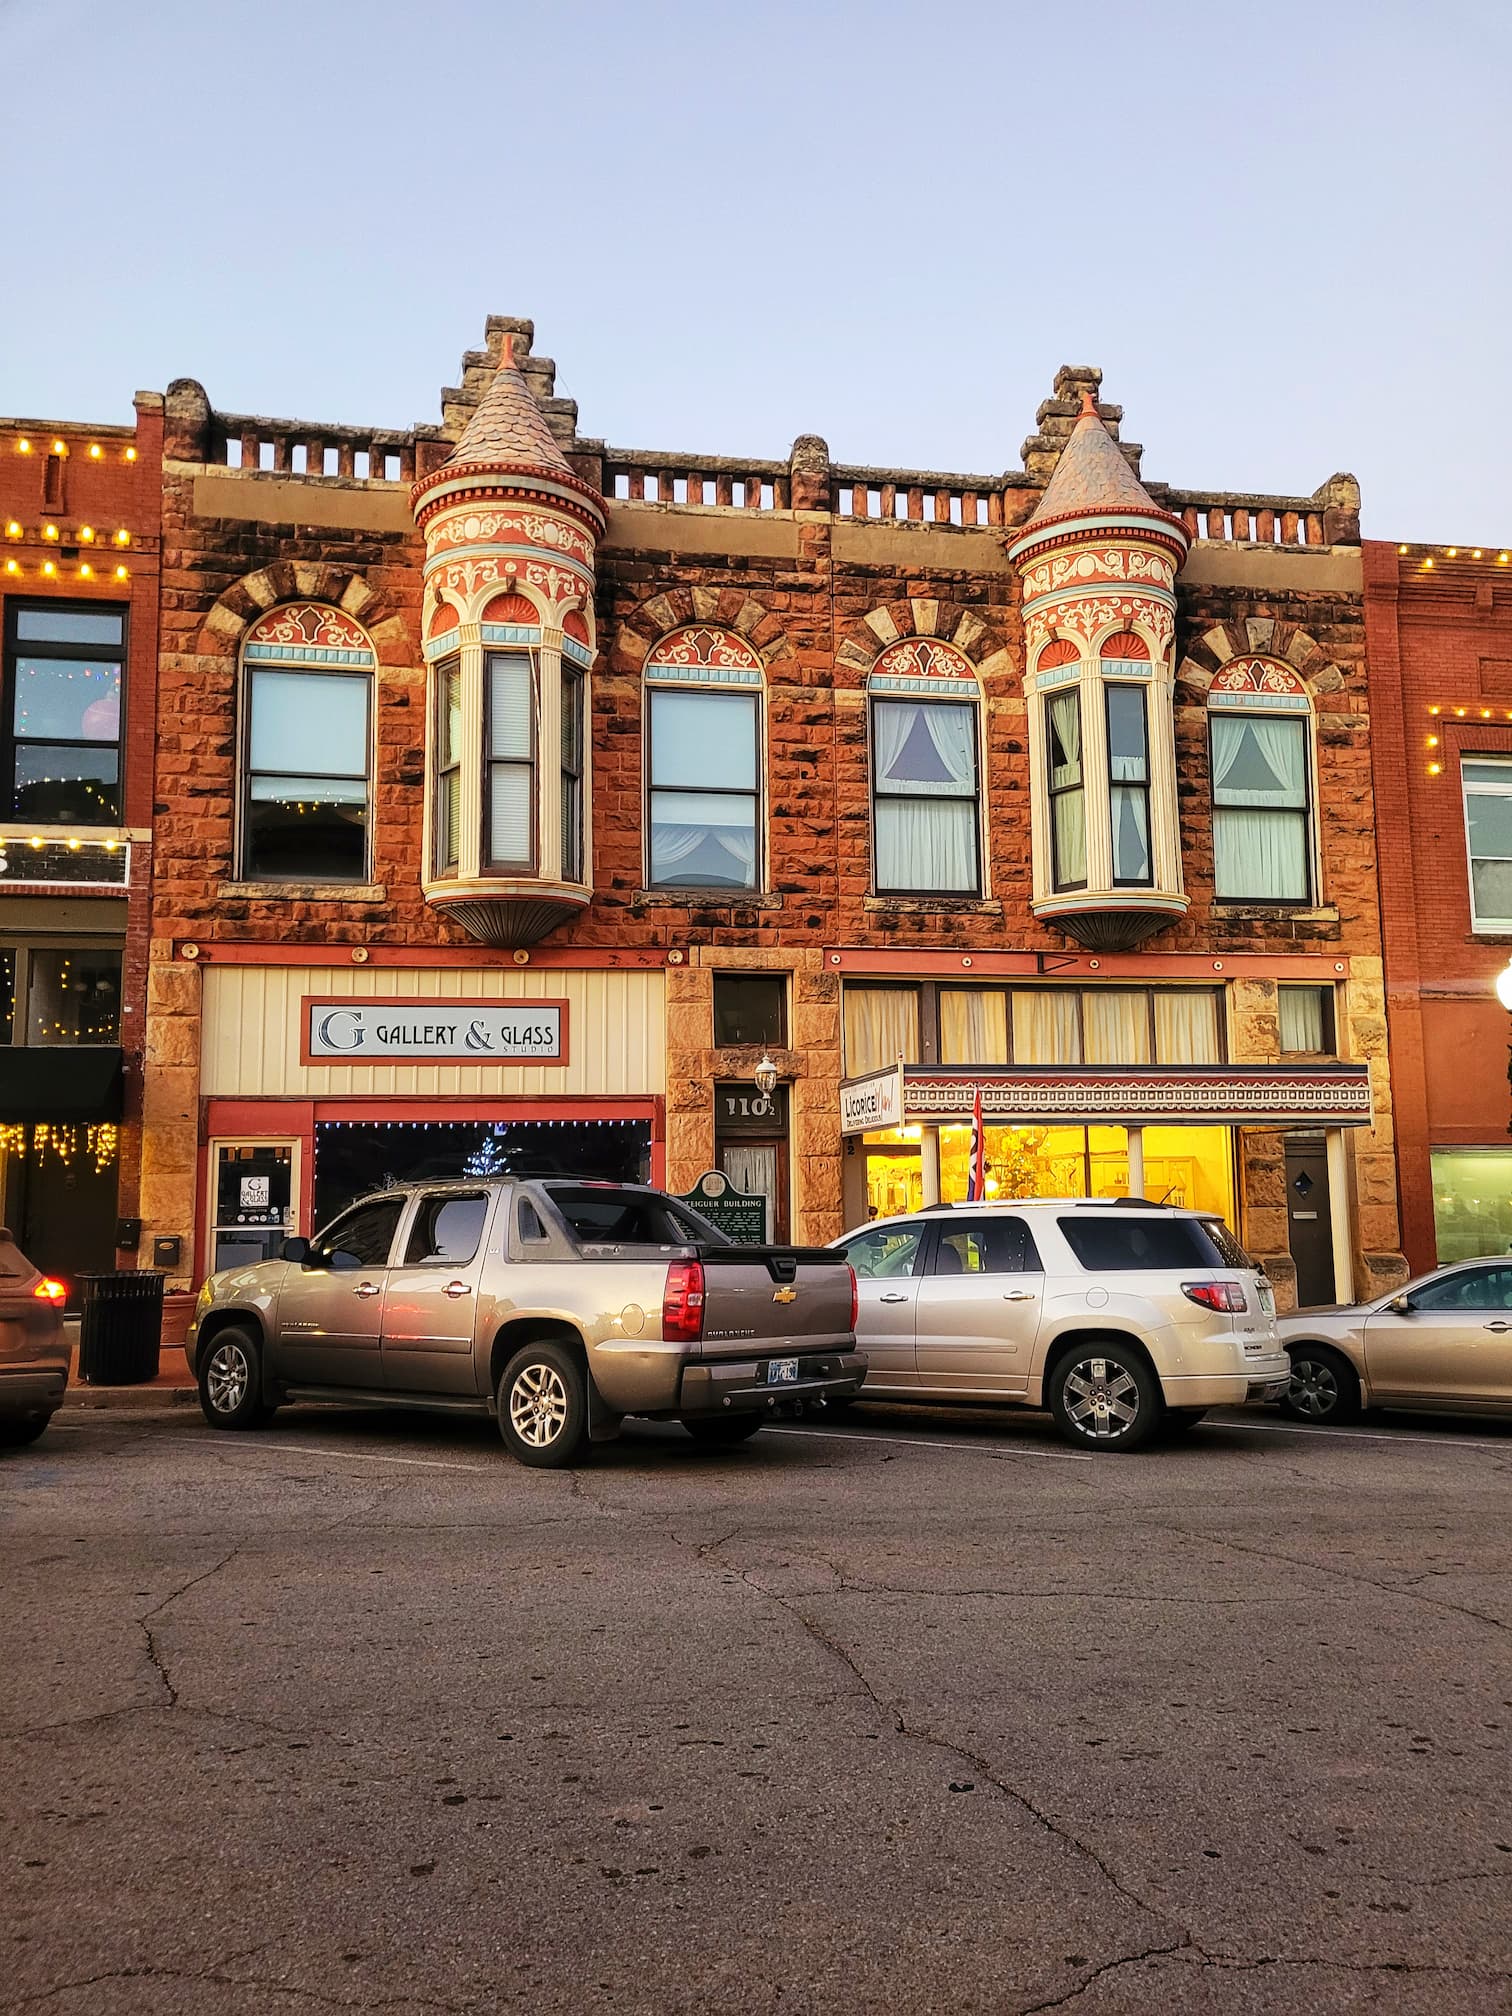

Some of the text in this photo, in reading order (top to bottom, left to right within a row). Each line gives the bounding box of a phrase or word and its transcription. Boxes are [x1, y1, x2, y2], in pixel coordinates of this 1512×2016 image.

[318, 1010, 553, 1050] G GALLERY & GLASS
[685, 1200, 720, 1208] TEIGUER
